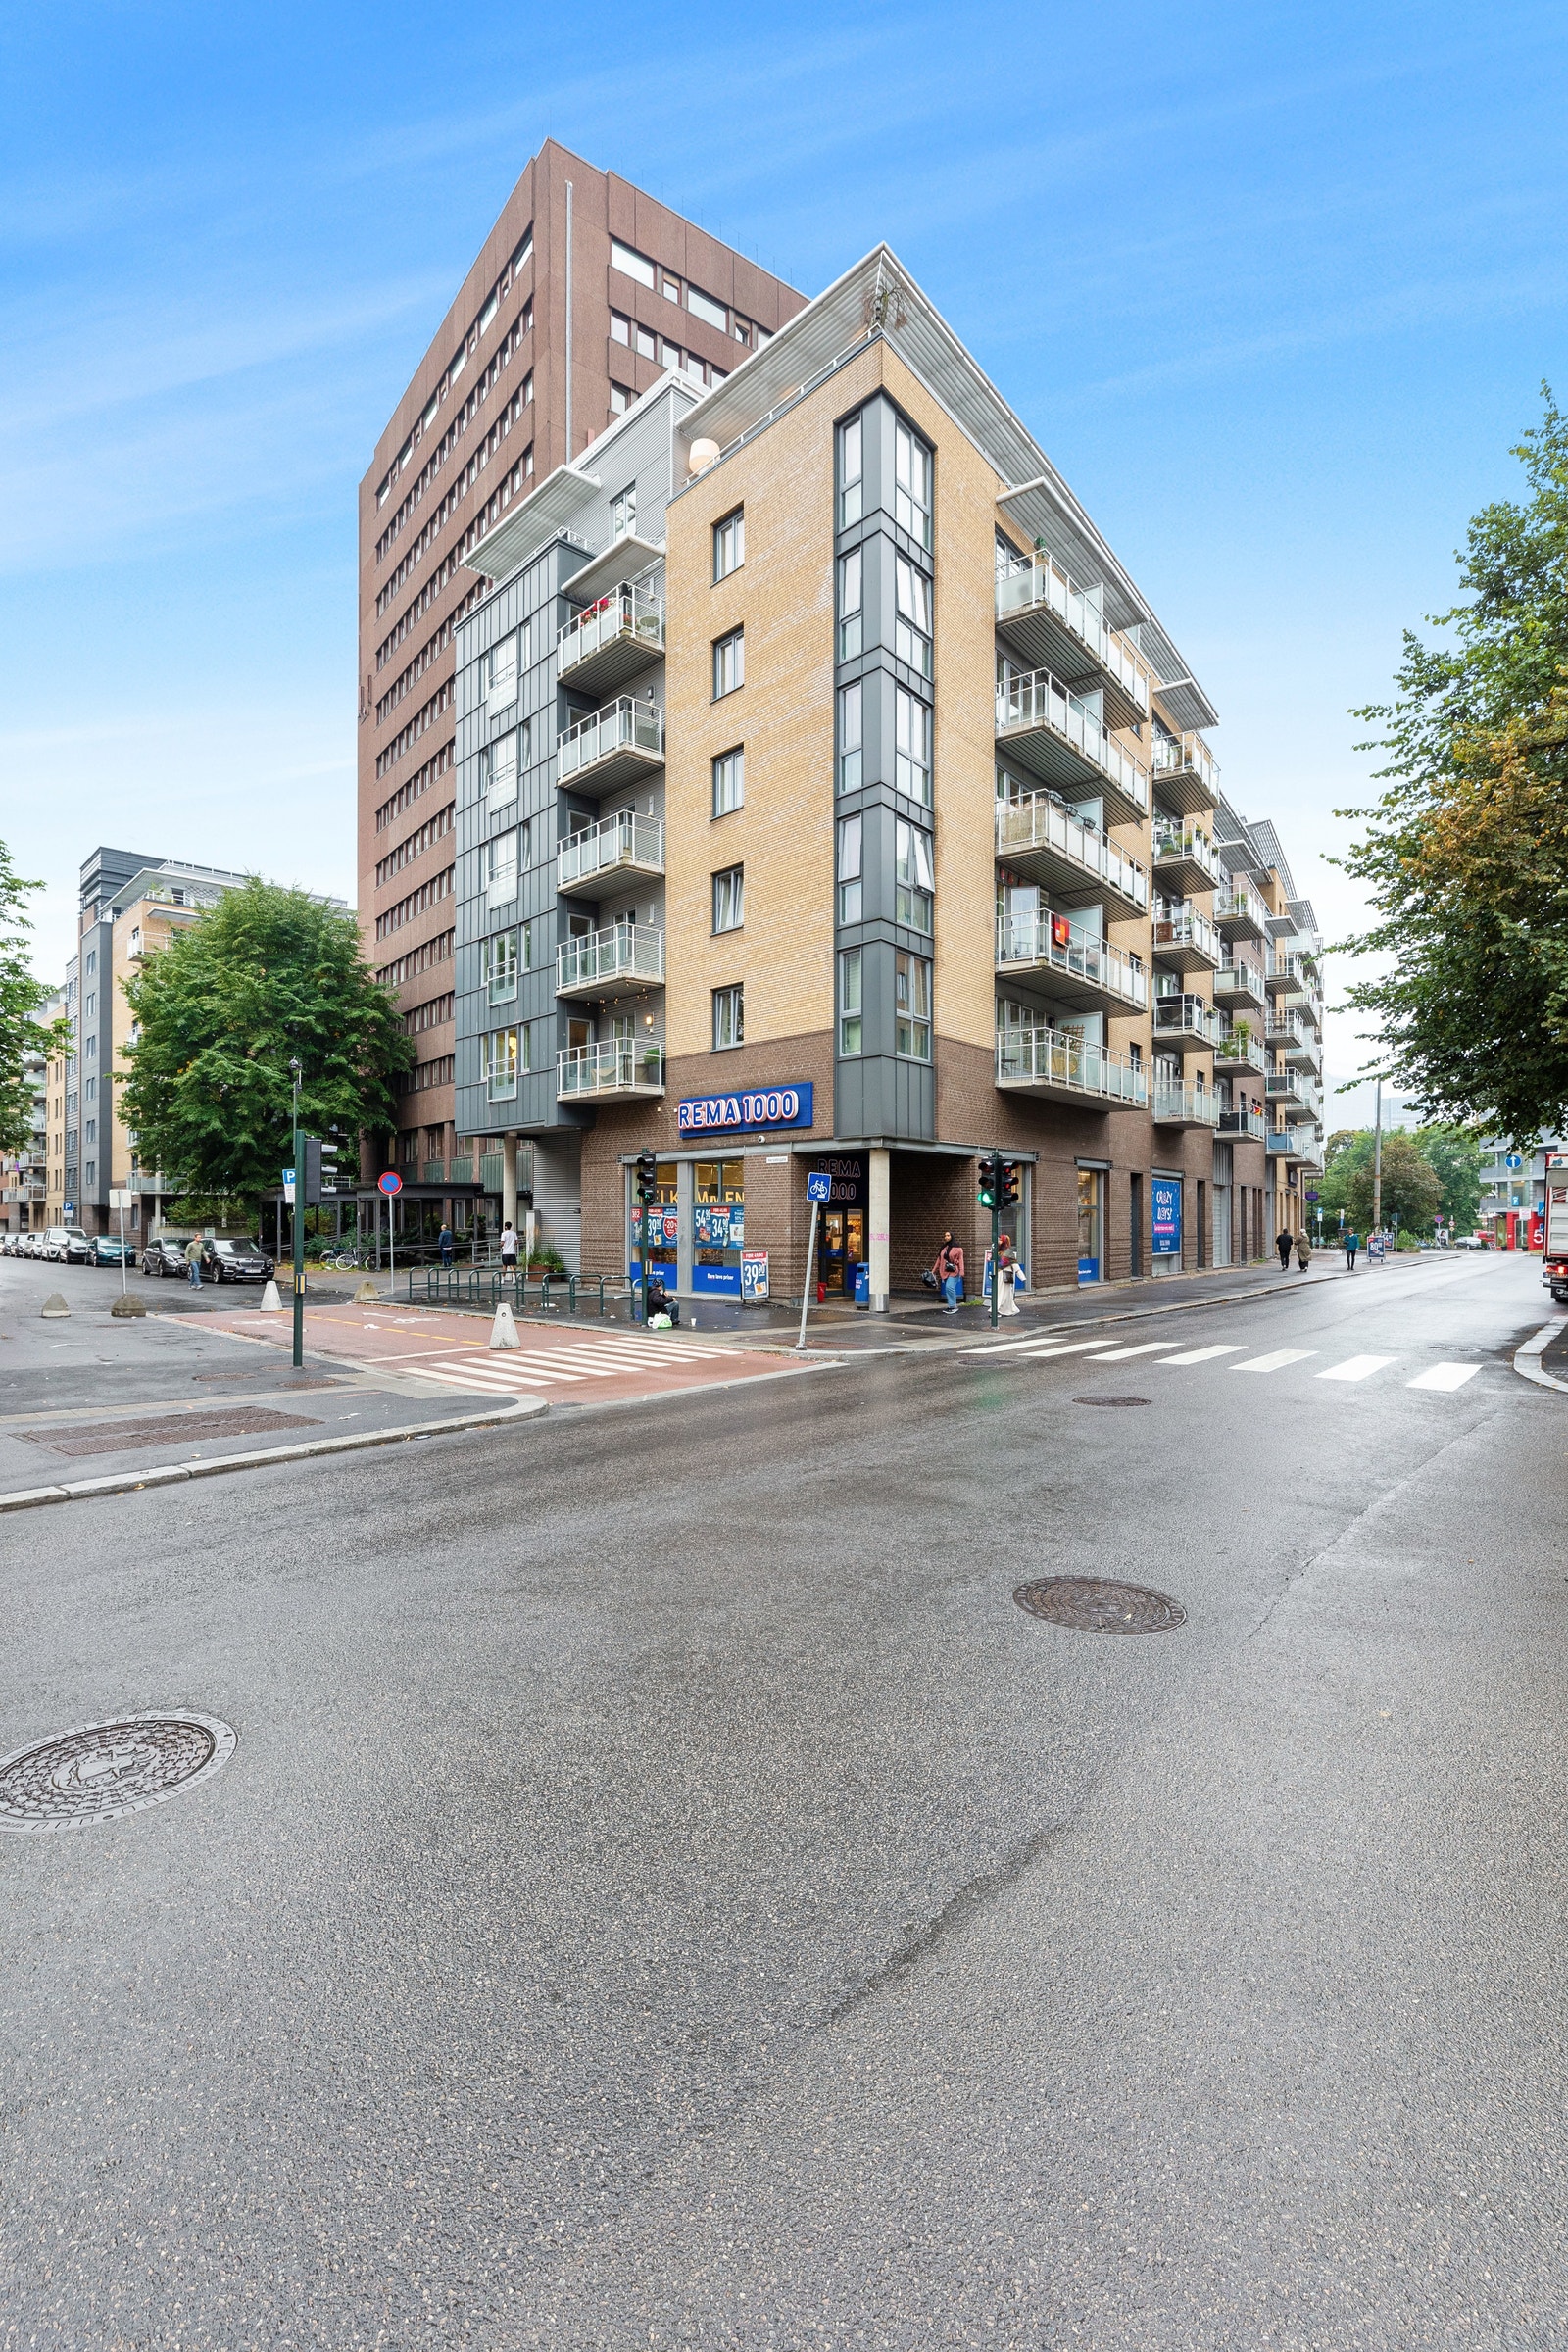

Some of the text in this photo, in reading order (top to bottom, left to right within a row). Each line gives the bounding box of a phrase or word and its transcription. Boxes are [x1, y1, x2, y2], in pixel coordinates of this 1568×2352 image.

[678, 1090, 799, 1129] REMA 1000
[286, 1170, 296, 1183] P
[817, 1158, 861, 1178] REMA
[829, 1183, 857, 1200] 000
[1156, 1190, 1173, 1204] CRAZY
[648, 1218, 657, 1236] 39
[695, 1209, 706, 1227] 54
[712, 1218, 723, 1237] 34
[1533, 1229, 1544, 1244] 5
[745, 1264, 765, 1286] 39 90
